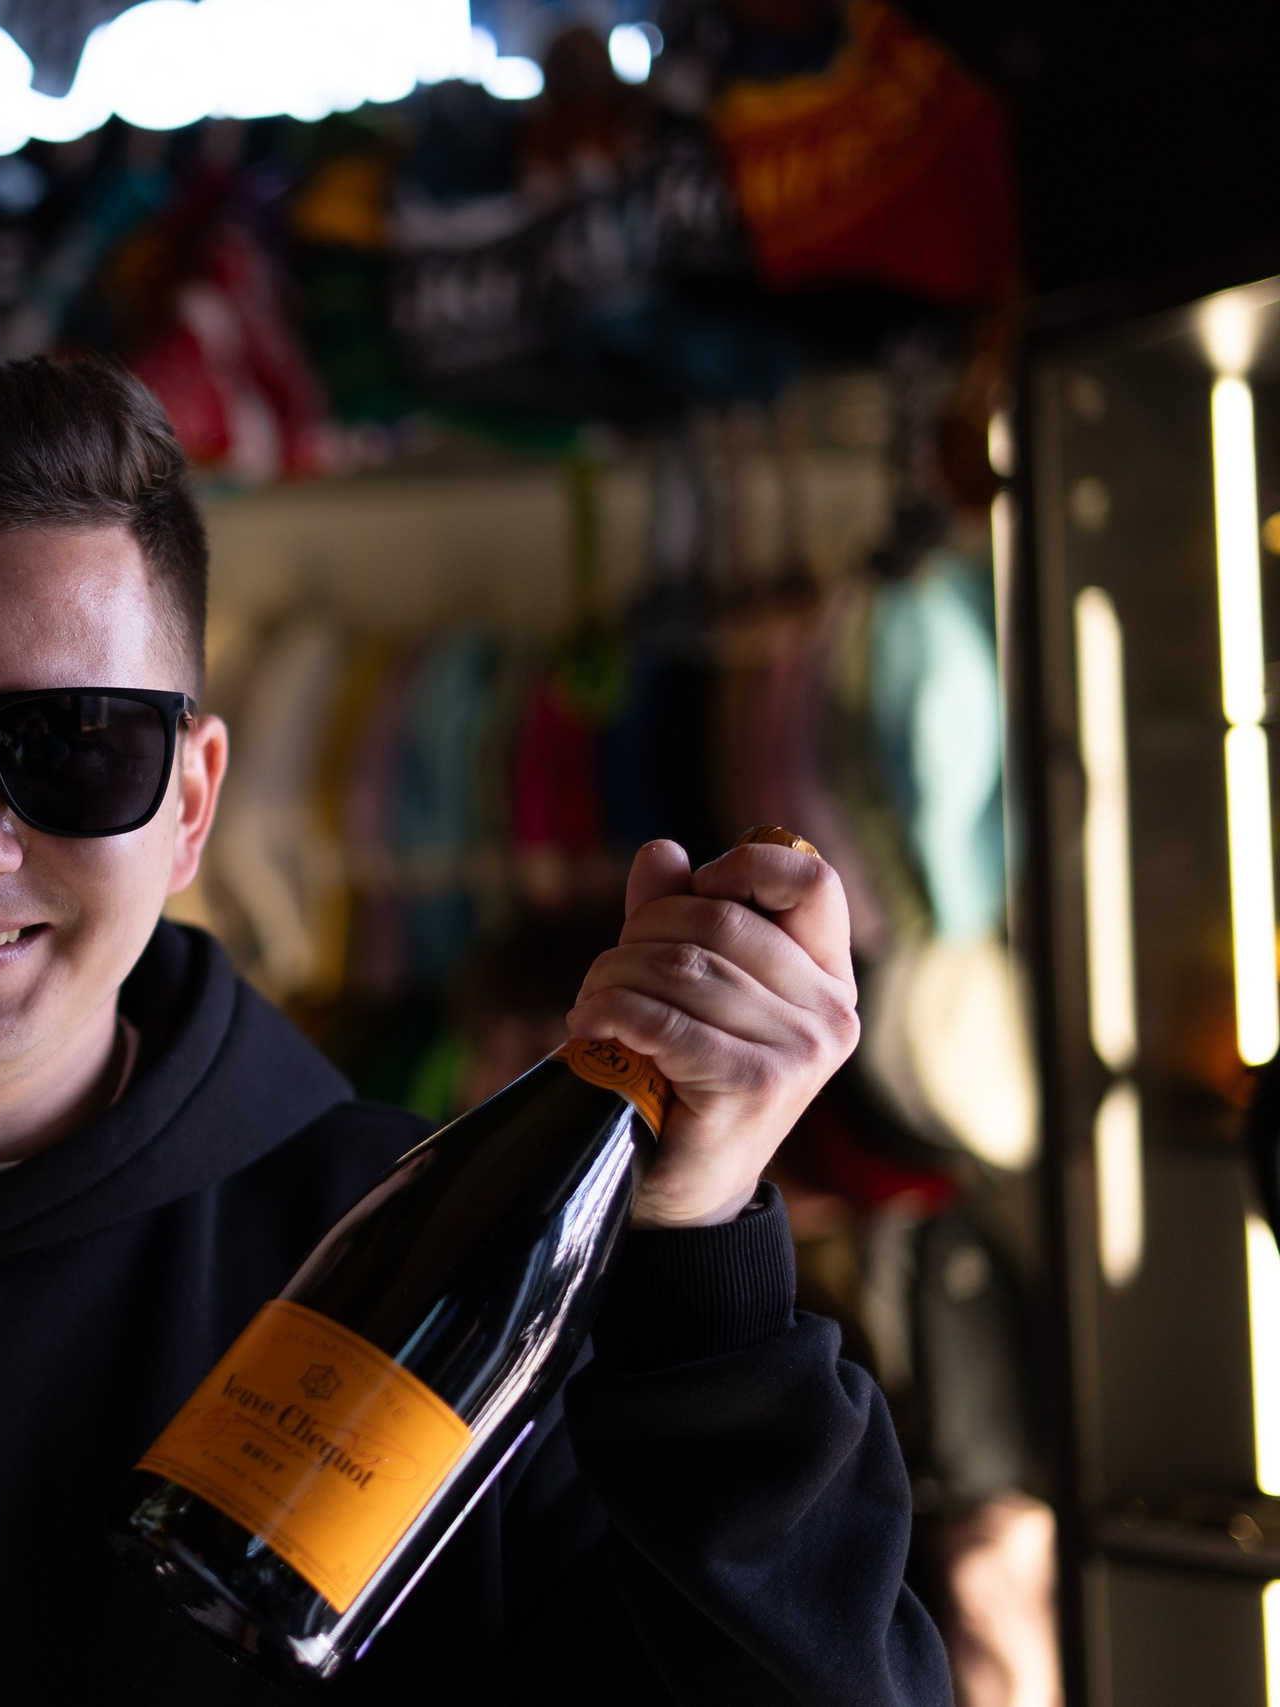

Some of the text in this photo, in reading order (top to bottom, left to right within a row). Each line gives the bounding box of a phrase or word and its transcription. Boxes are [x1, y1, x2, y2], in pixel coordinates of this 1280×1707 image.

[582, 1041, 630, 1073] 250
[647, 1078, 664, 1105] Veu
[222, 1372, 275, 1415] Veuve
[278, 1404, 375, 1492] Clicquot
[241, 1441, 285, 1474] BRUT
